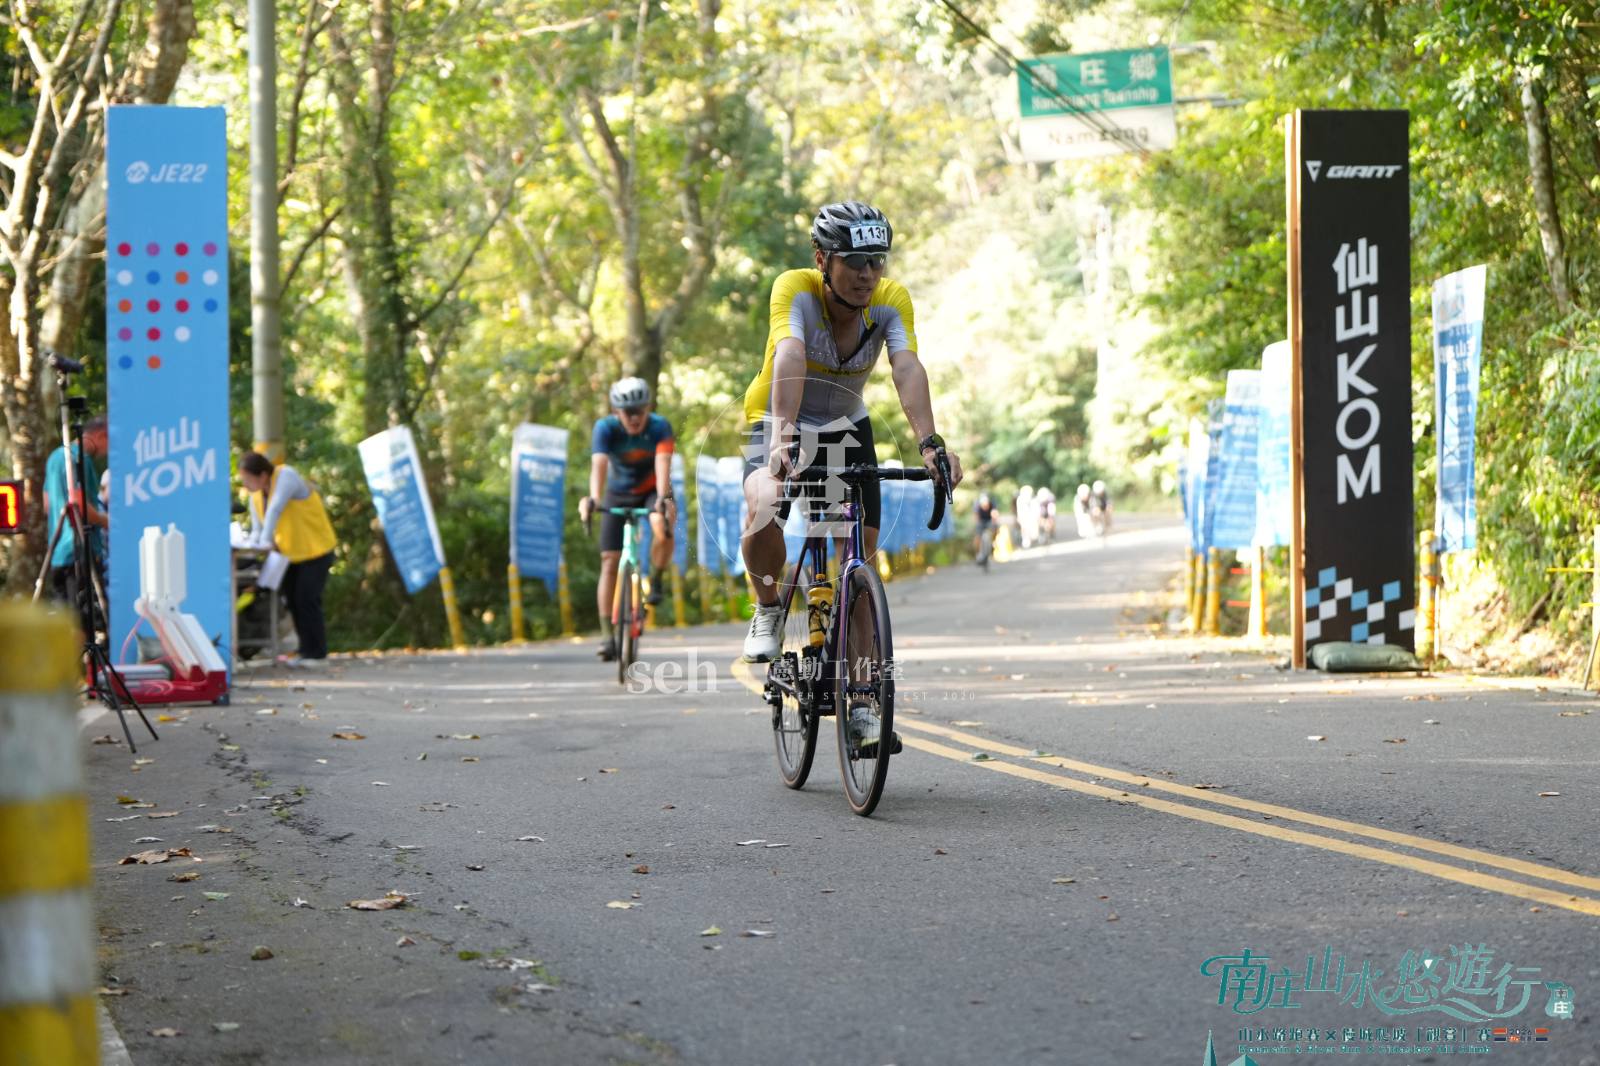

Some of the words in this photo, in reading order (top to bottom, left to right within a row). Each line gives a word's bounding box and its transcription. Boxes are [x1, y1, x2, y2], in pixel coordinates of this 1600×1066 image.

[1102, 86, 1160, 105] Township
[151, 163, 208, 183] JE22
[1326, 164, 1402, 179] GIANT
[132, 416, 200, 466] 仙山
[124, 447, 216, 506] KOM
